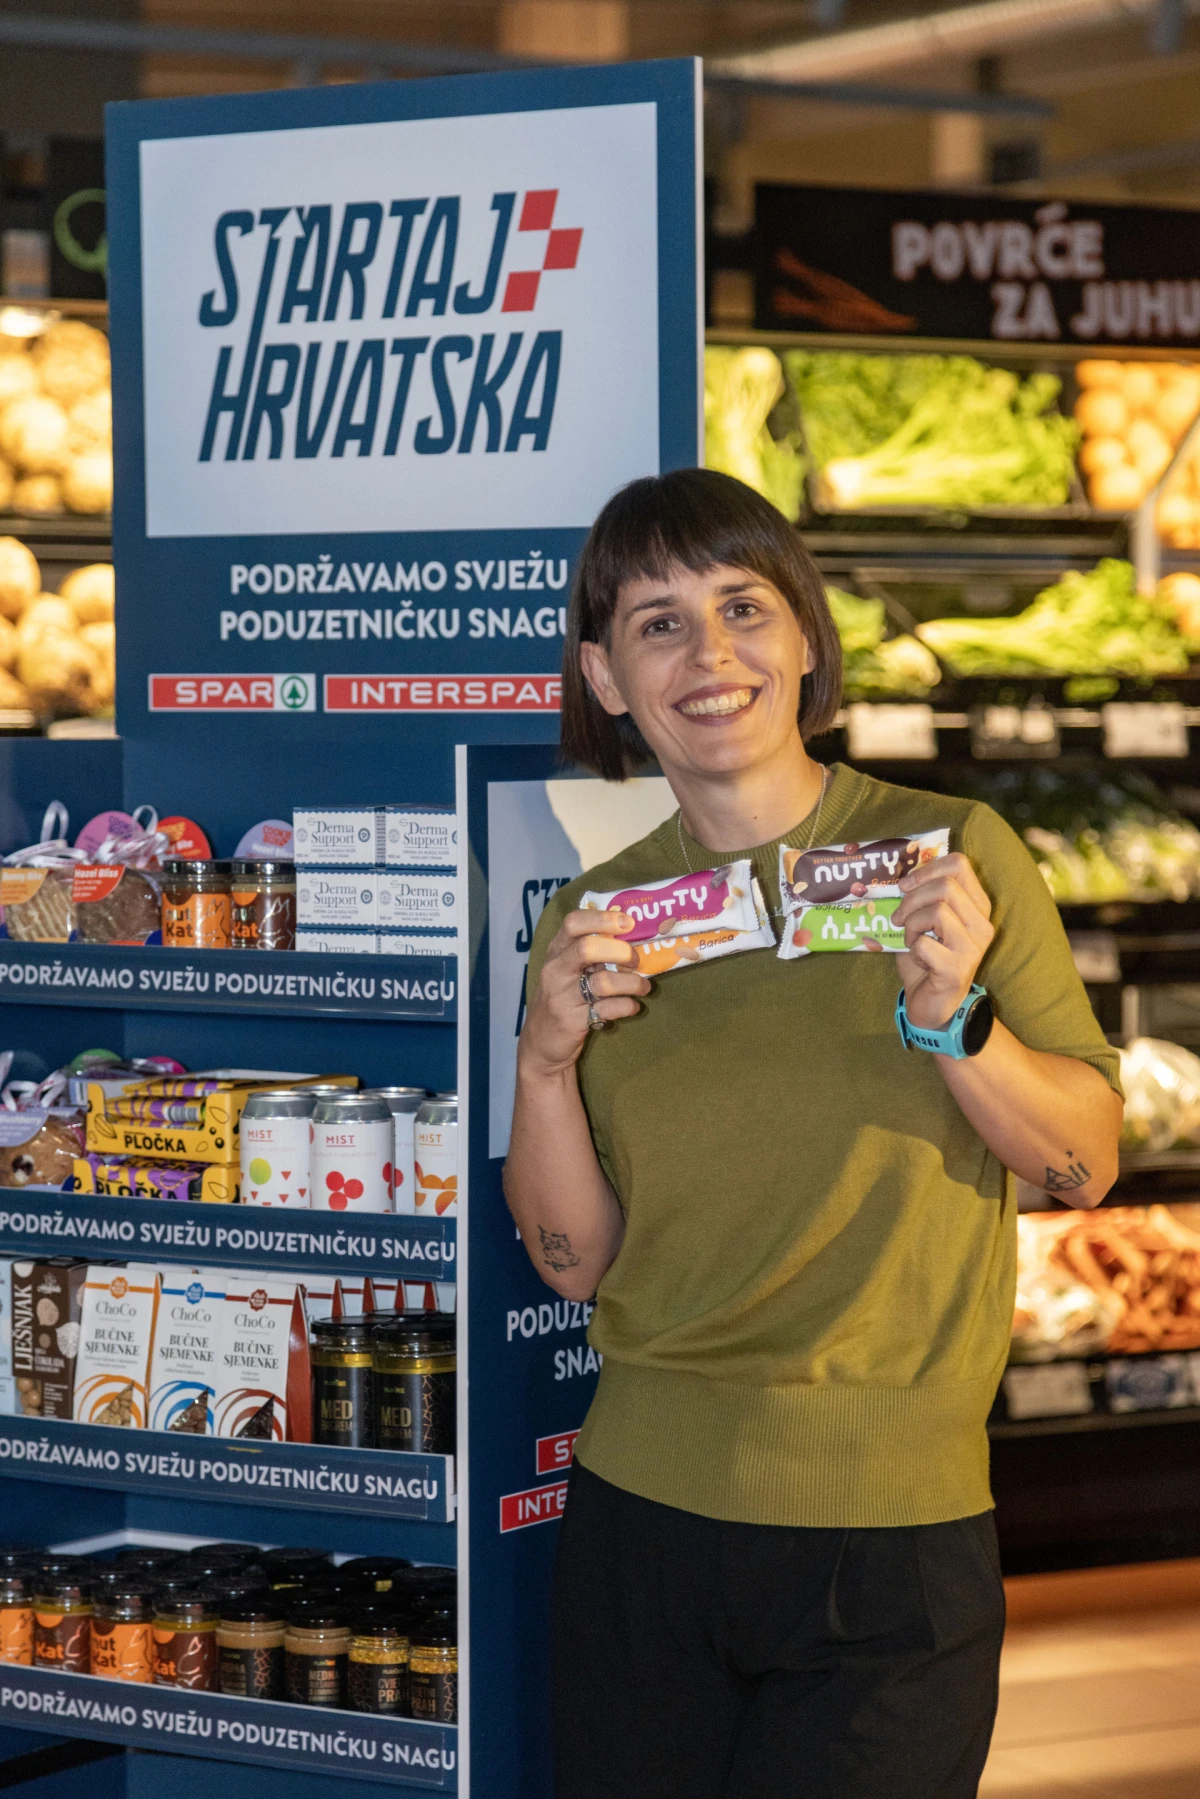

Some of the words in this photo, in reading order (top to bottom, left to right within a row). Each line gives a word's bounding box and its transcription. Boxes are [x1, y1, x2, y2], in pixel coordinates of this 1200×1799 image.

[199, 191, 518, 327] STARTAJ
[990, 280, 1061, 339] ZA
[1070, 279, 1200, 337] JUHU
[198, 330, 563, 462] HRVATSKA
[231, 554, 448, 594] PODRŽAVAMO
[454, 550, 568, 592] SVJEŽU
[220, 600, 461, 641] PODUZETNIČKU
[175, 681, 274, 704] SPAR
[315, 820, 355, 833] Derma
[408, 822, 448, 835] Derma
[311, 832, 355, 847] Support
[403, 833, 448, 848] Support
[319, 881, 357, 895] Derma
[400, 884, 438, 897] Derma
[871, 877, 899, 889] Baric
[314, 894, 357, 908] Support
[394, 894, 438, 910] Support
[679, 912, 717, 925] Barica
[166, 922, 193, 938] Kat
[233, 922, 258, 938] Kat
[699, 934, 735, 951] Barica
[0, 960, 134, 989] PODRŽAVAMO
[139, 966, 210, 993] SVJEŽU
[215, 971, 376, 999] PODUZETNIČKU
[381, 978, 455, 1001] SNAGU
[247, 1129, 273, 1139] MIST
[326, 1135, 355, 1144] MIST
[418, 1133, 443, 1143] MIST
[124, 1132, 188, 1153] PLOČKA
[0, 1211, 135, 1241] PODRŽAVAMO
[140, 1220, 211, 1247] SVJEŽU
[216, 1228, 376, 1257] PODUZETNIČKU
[382, 1236, 455, 1262] SNAGU
[95, 1300, 137, 1317] ChoCo
[171, 1306, 212, 1323] ChoCo
[11, 1284, 34, 1371] LJEŠNJAK
[234, 1313, 276, 1329] ChoCo
[94, 1326, 135, 1342] BUČINE
[169, 1332, 210, 1348] BUČINE
[84, 1340, 140, 1357] SJEMENKE
[160, 1346, 214, 1362] SJEMENKE
[233, 1339, 274, 1355] BUČINE
[223, 1354, 280, 1370] SJEMENKE
[321, 1399, 353, 1420] MED
[381, 1406, 412, 1428] MED
[0, 1437, 120, 1470] ODRŽAVAMO
[125, 1451, 195, 1479] SVJEŽU
[200, 1460, 359, 1494] PODUZETNIČKU
[364, 1475, 438, 1500] SNAGU
[35, 1641, 64, 1660] Kat
[94, 1652, 117, 1668] Kat
[153, 1657, 177, 1677] Kat
[1, 1687, 137, 1726] PODRŽAVAMO
[142, 1708, 212, 1738] SVJEŽU
[217, 1719, 377, 1760] PODUZETNIČKU
[382, 1742, 455, 1770] SNAGU
